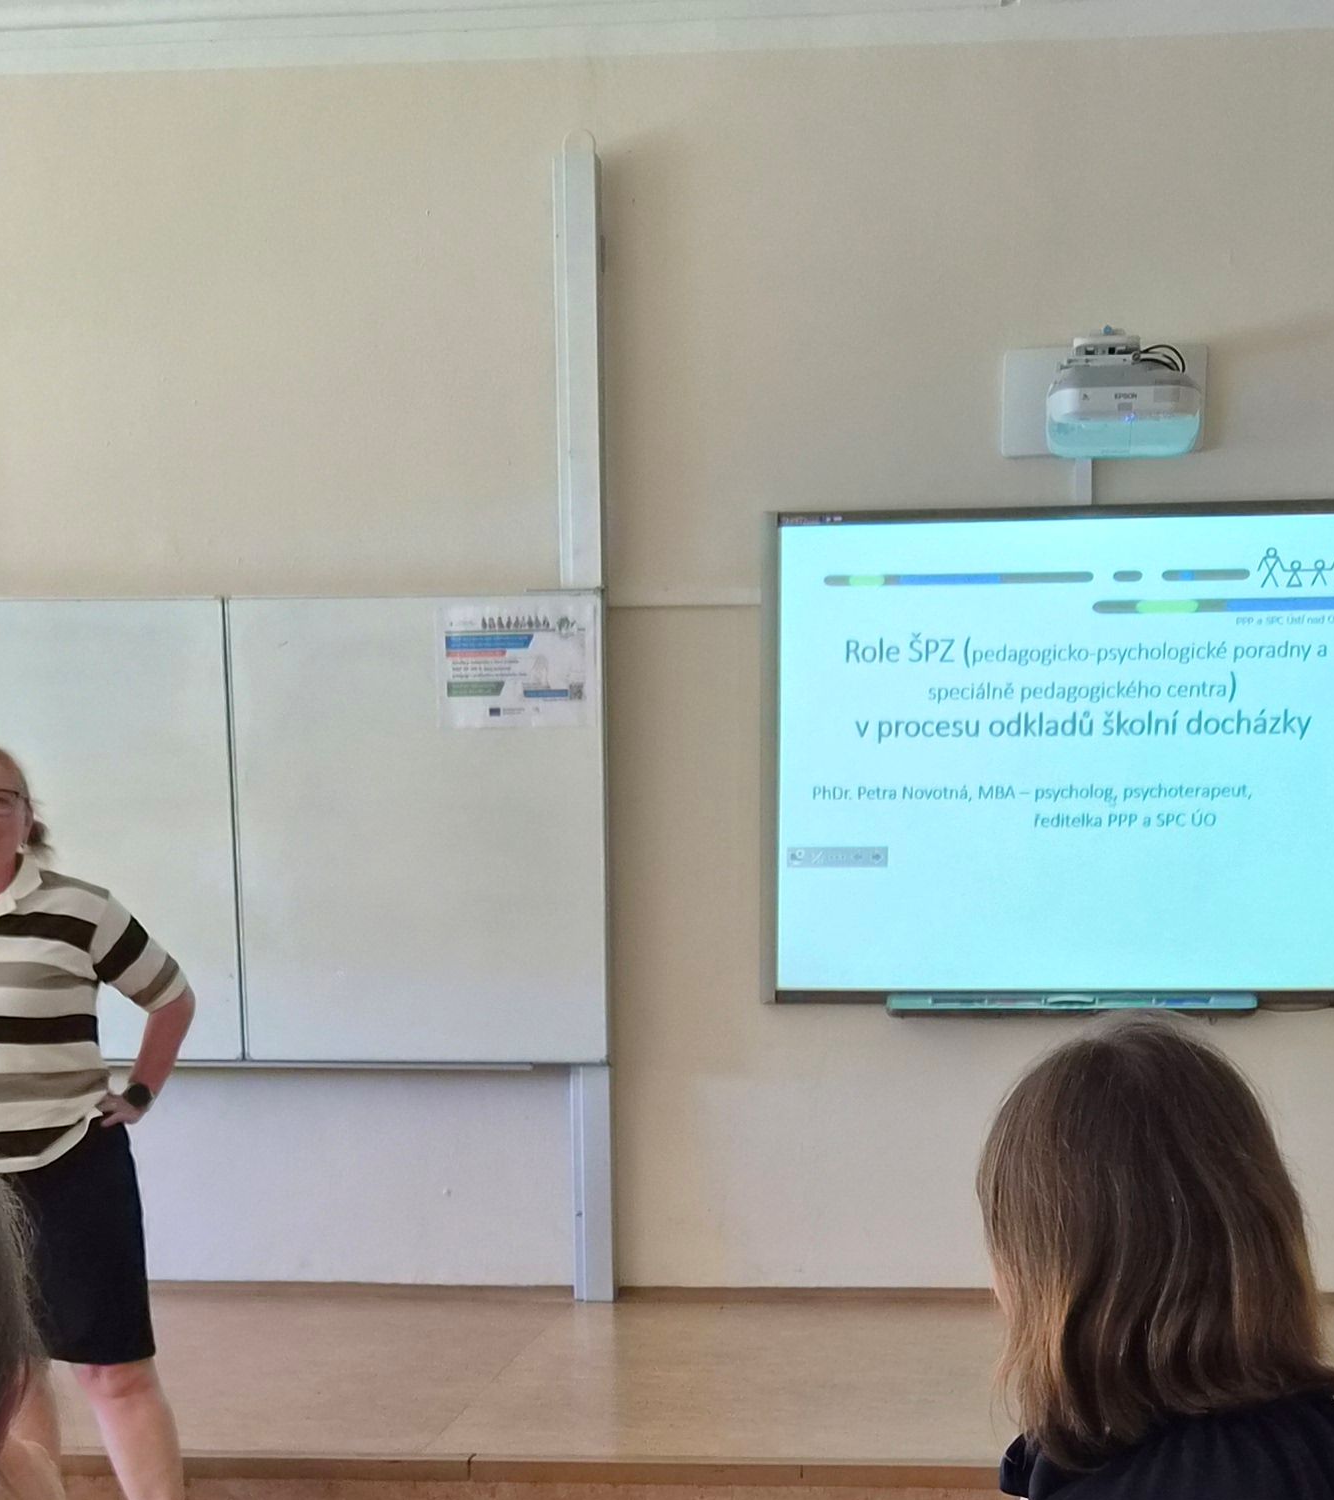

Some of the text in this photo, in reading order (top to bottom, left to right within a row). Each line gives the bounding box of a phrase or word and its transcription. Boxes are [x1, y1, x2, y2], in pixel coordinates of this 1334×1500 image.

[845, 632, 1328, 669] Role ŠPZ (pedagogicko-psychologické poradny a
[928, 670, 1237, 704] speciálně pedagogického centra)
[855, 708, 1313, 744] v procesu odkladů školní docházky
[812, 786, 852, 800] PhDr.
[857, 786, 897, 800] Petra
[902, 785, 972, 802] Novotná,
[978, 785, 1016, 800] MBA
[1034, 783, 1118, 803] psycholog,
[1123, 783, 1253, 801] psychoterapeut,
[1034, 809, 1217, 828] ředitelka PPP a SPC ÚO
